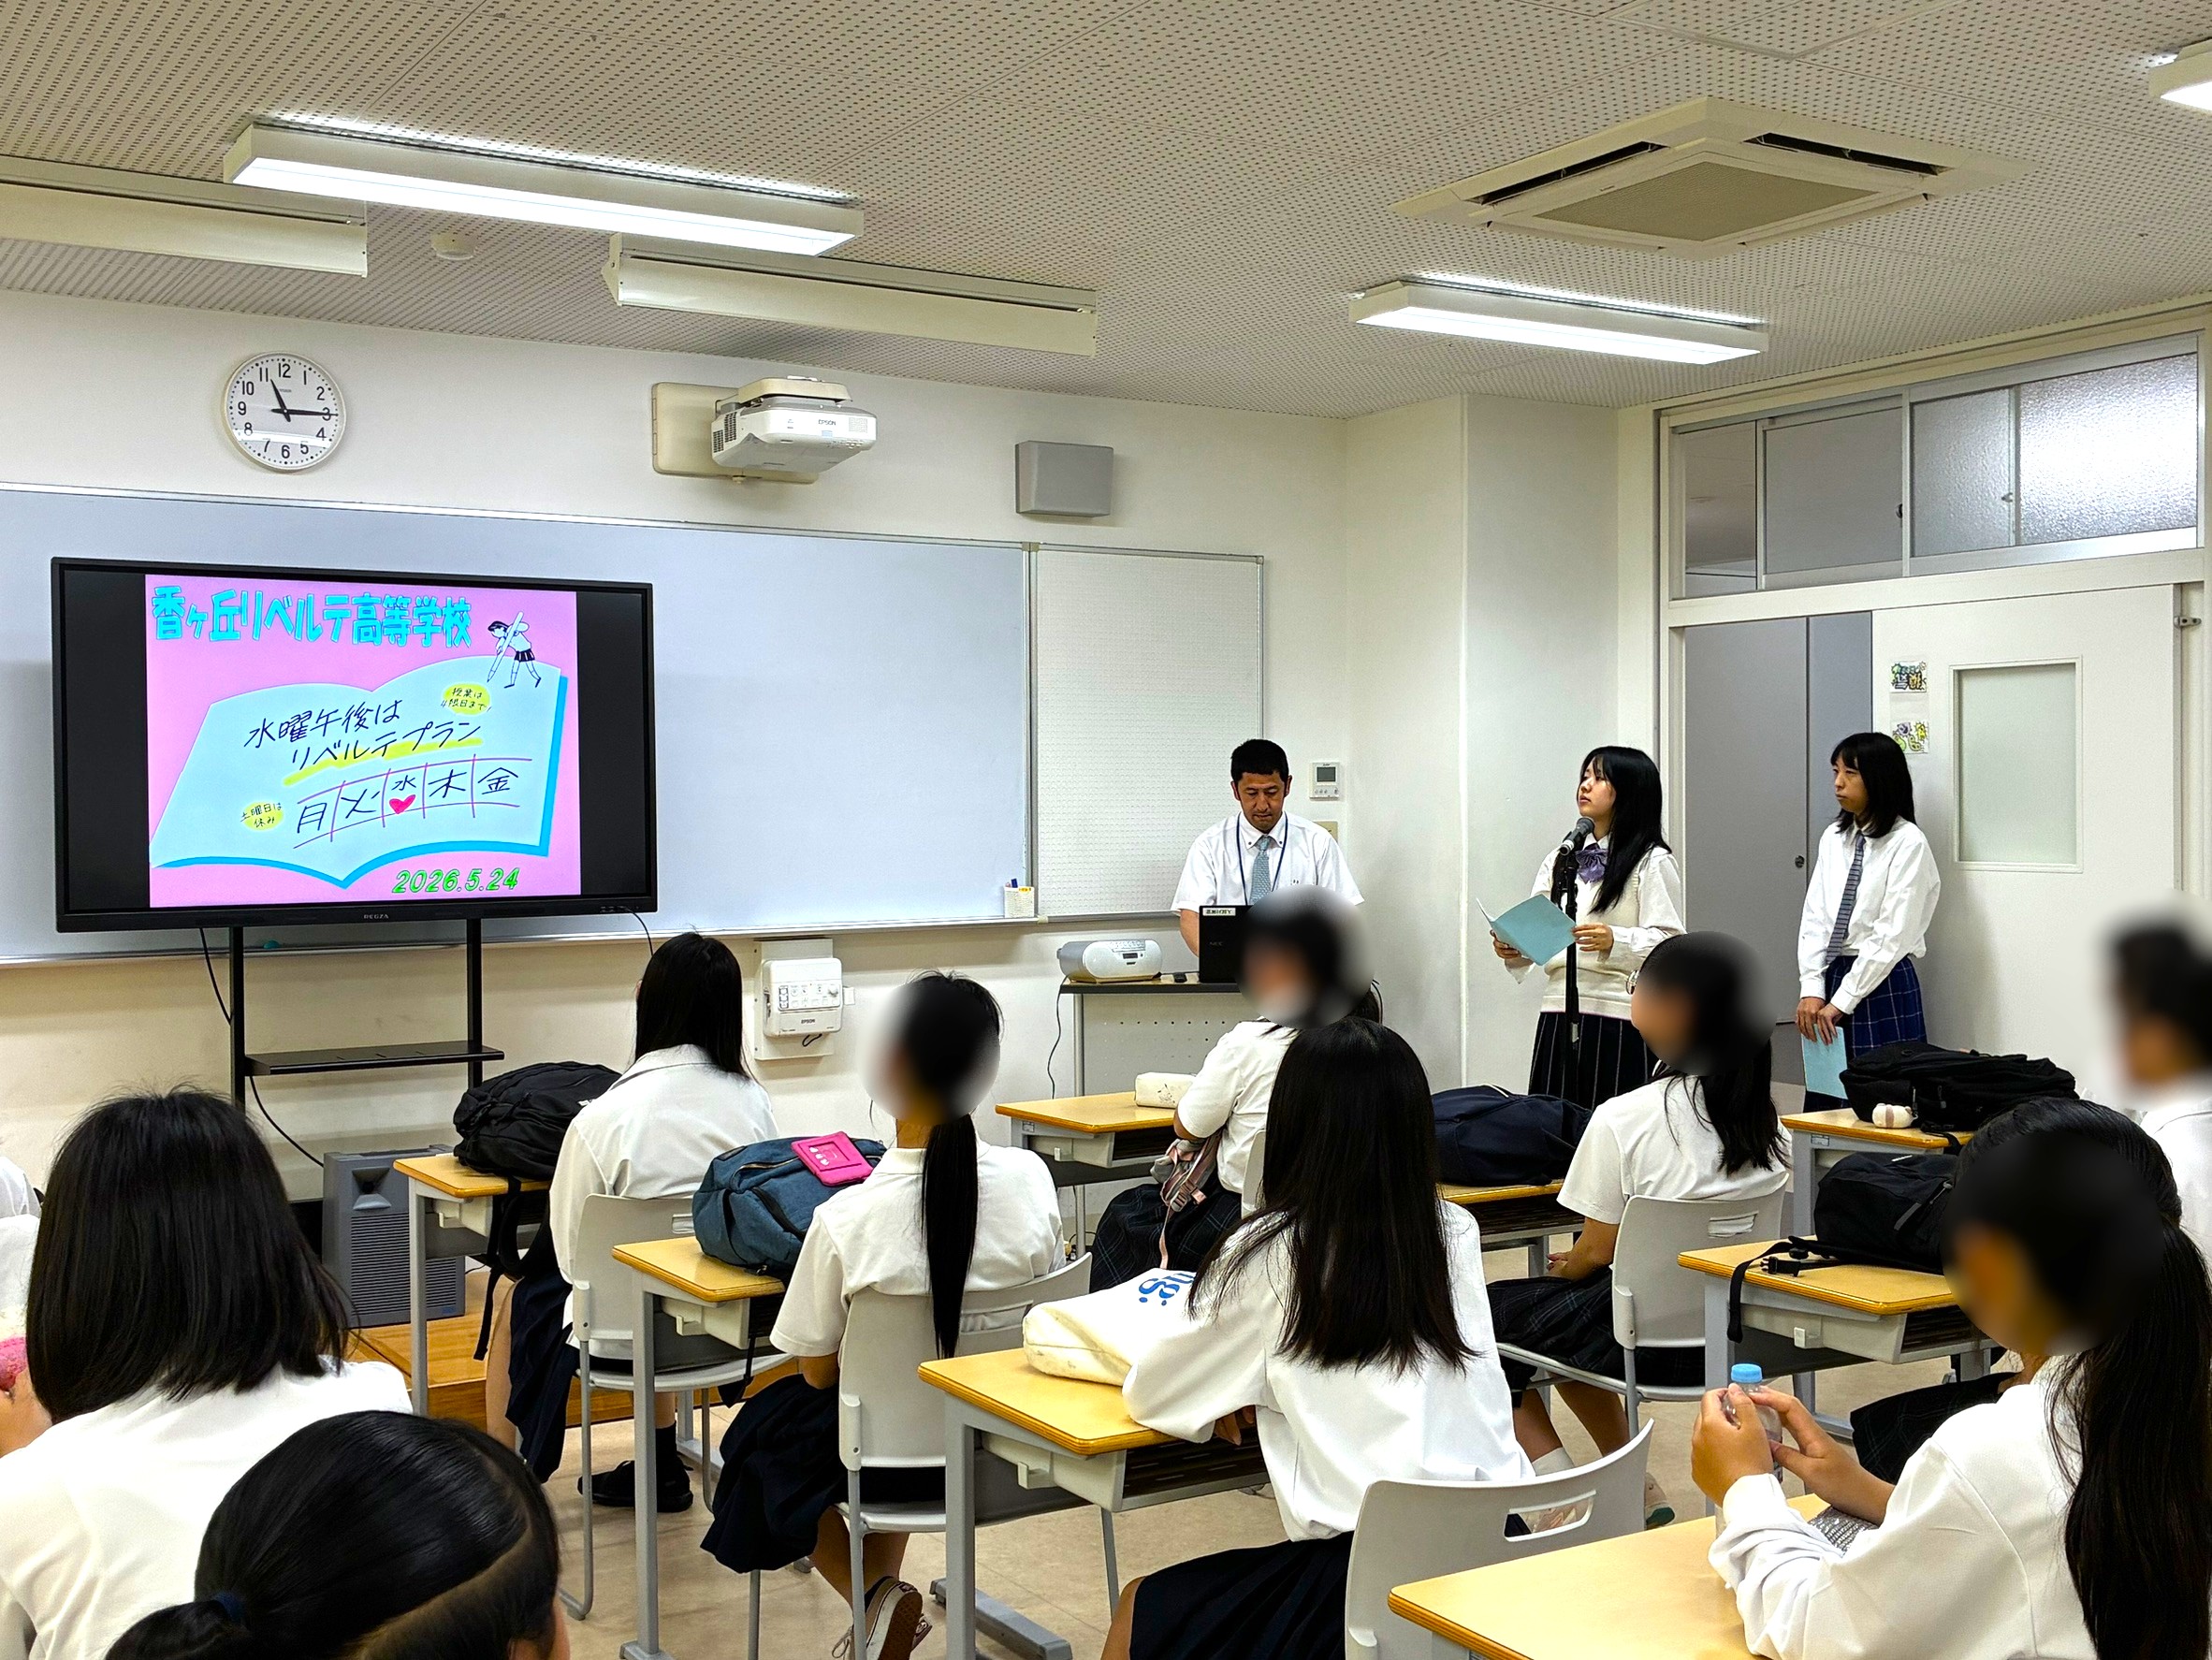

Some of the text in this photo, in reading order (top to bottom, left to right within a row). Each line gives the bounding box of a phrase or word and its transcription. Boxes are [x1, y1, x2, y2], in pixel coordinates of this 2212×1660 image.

[259, 368, 269, 382] 11
[278, 362, 292, 379] 12
[303, 371, 307, 385] 1
[241, 380, 255, 396] 10
[316, 386, 325, 400] 2
[238, 401, 247, 415] 9
[322, 407, 331, 421] 3
[244, 422, 253, 436] 8
[818, 418, 837, 427] EPSON
[315, 428, 327, 441] 4
[263, 440, 271, 453] 7
[281, 444, 290, 459] 6
[300, 443, 309, 455] 5
[243, 699, 403, 749] 水曜午後は
[292, 721, 482, 770] リベルテプラン
[297, 766, 519, 834] 月 火 水 木 金
[391, 866, 520, 894] 2026.5.24
